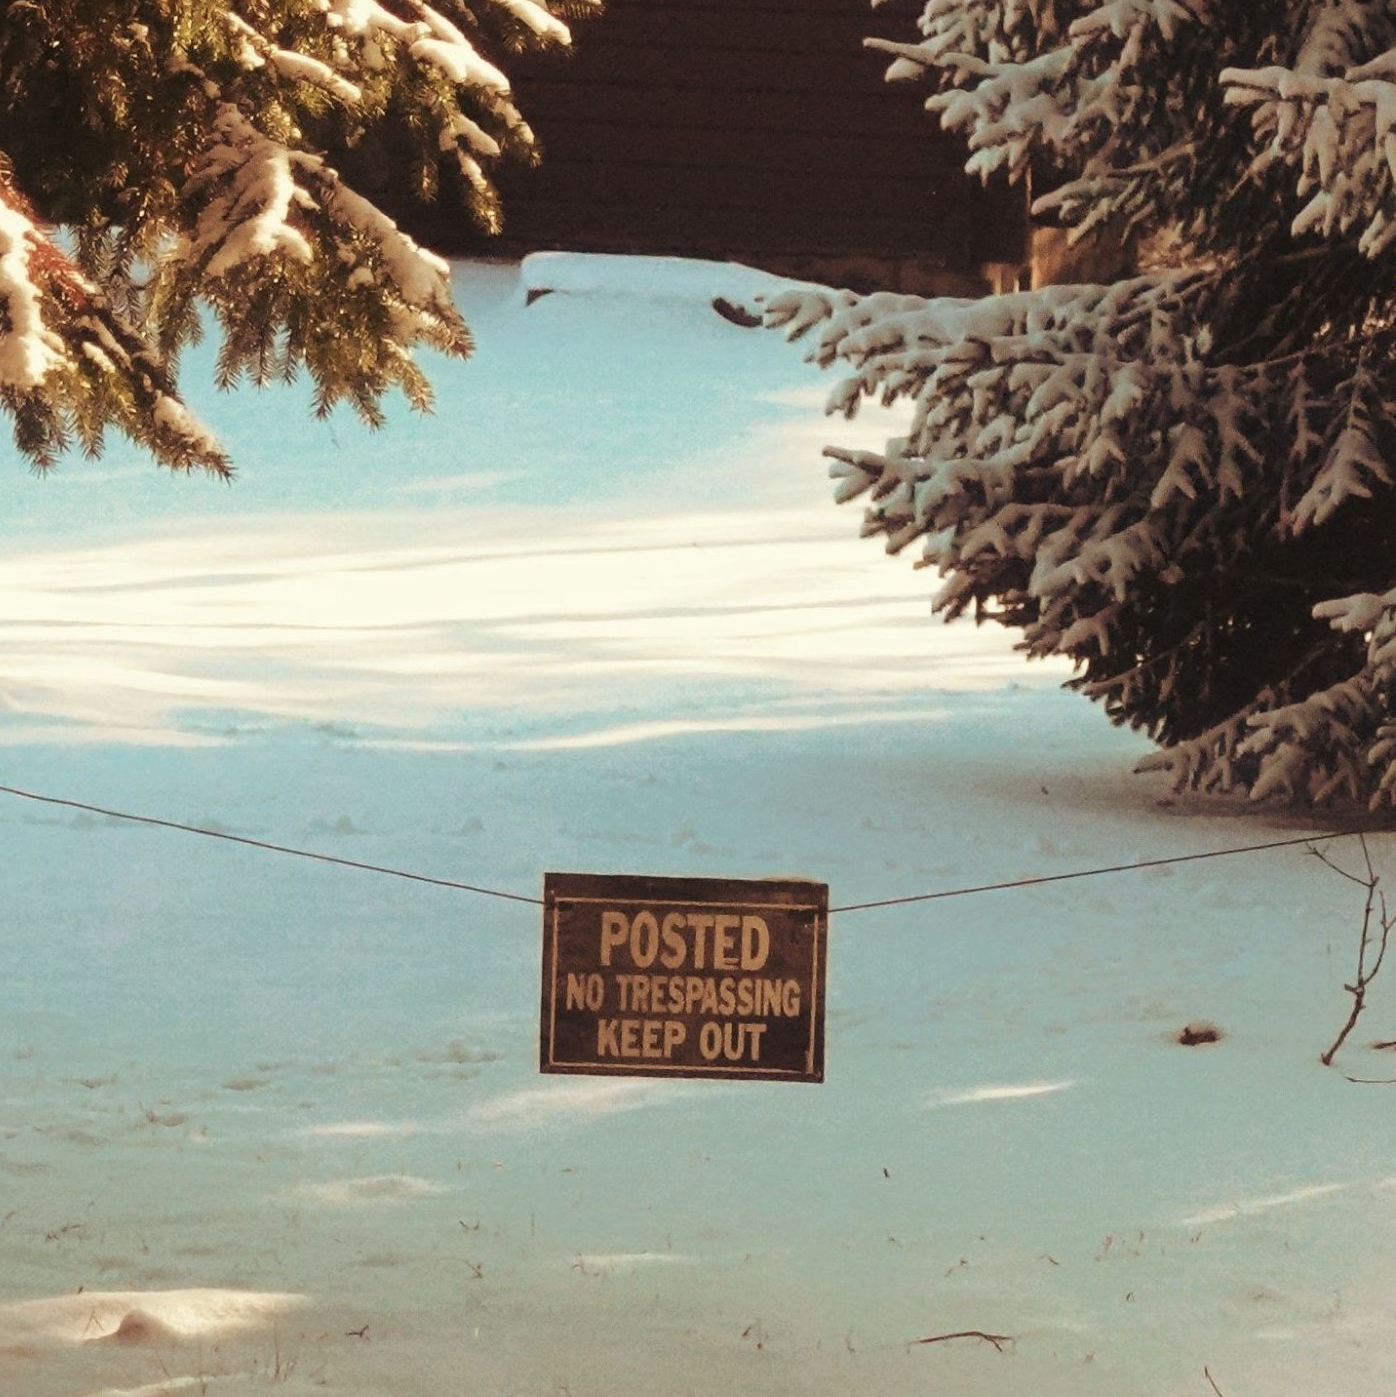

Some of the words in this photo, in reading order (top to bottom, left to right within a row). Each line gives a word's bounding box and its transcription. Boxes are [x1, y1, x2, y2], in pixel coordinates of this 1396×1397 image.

[600, 910, 770, 971] POSTED
[565, 972, 604, 1011] NO
[616, 974, 801, 1017] TRESPASSING
[597, 1018, 686, 1058] KEEP
[699, 1021, 767, 1061] OUT
